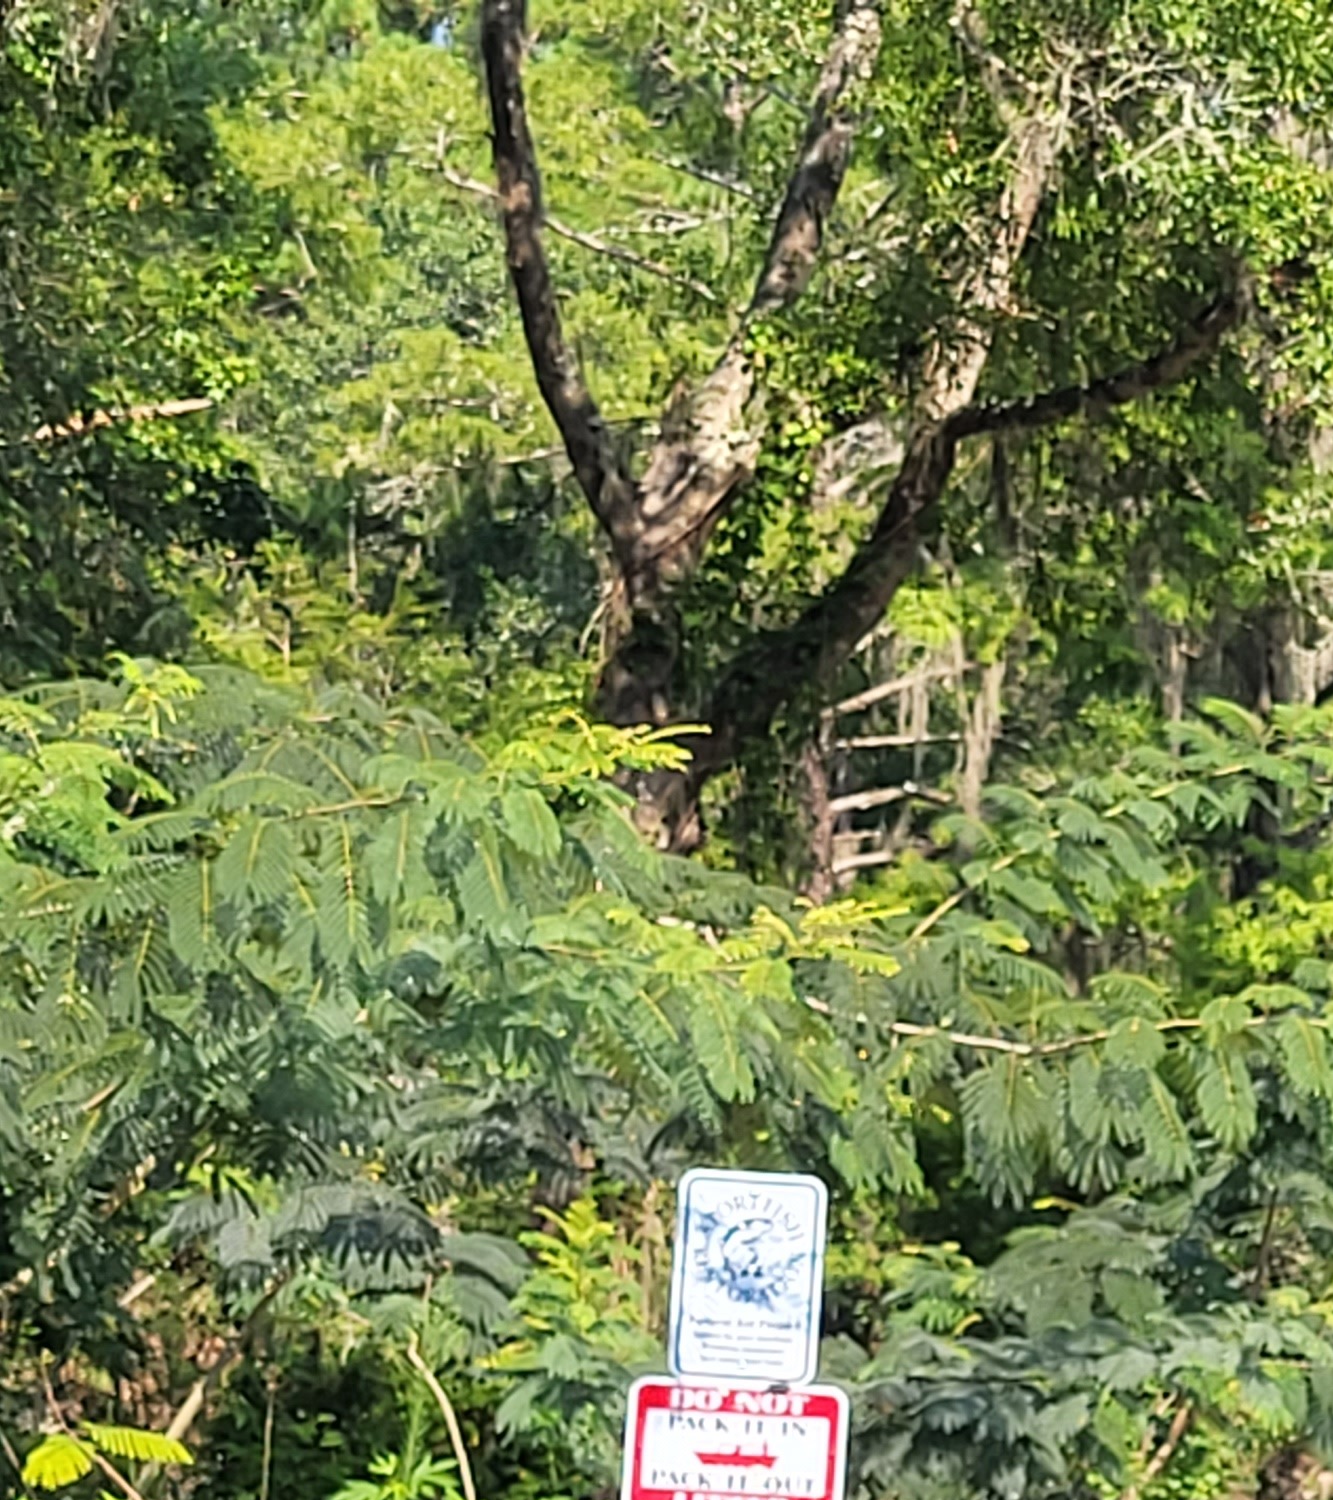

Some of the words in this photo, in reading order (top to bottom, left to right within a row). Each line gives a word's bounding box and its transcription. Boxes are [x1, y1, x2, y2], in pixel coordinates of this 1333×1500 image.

[670, 1387, 723, 1411] DO
[734, 1389, 811, 1416] NOT
[669, 1413, 728, 1432] PACK
[782, 1422, 806, 1436] IN
[652, 1469, 711, 1489] PACK
[764, 1475, 814, 1494] OUT
